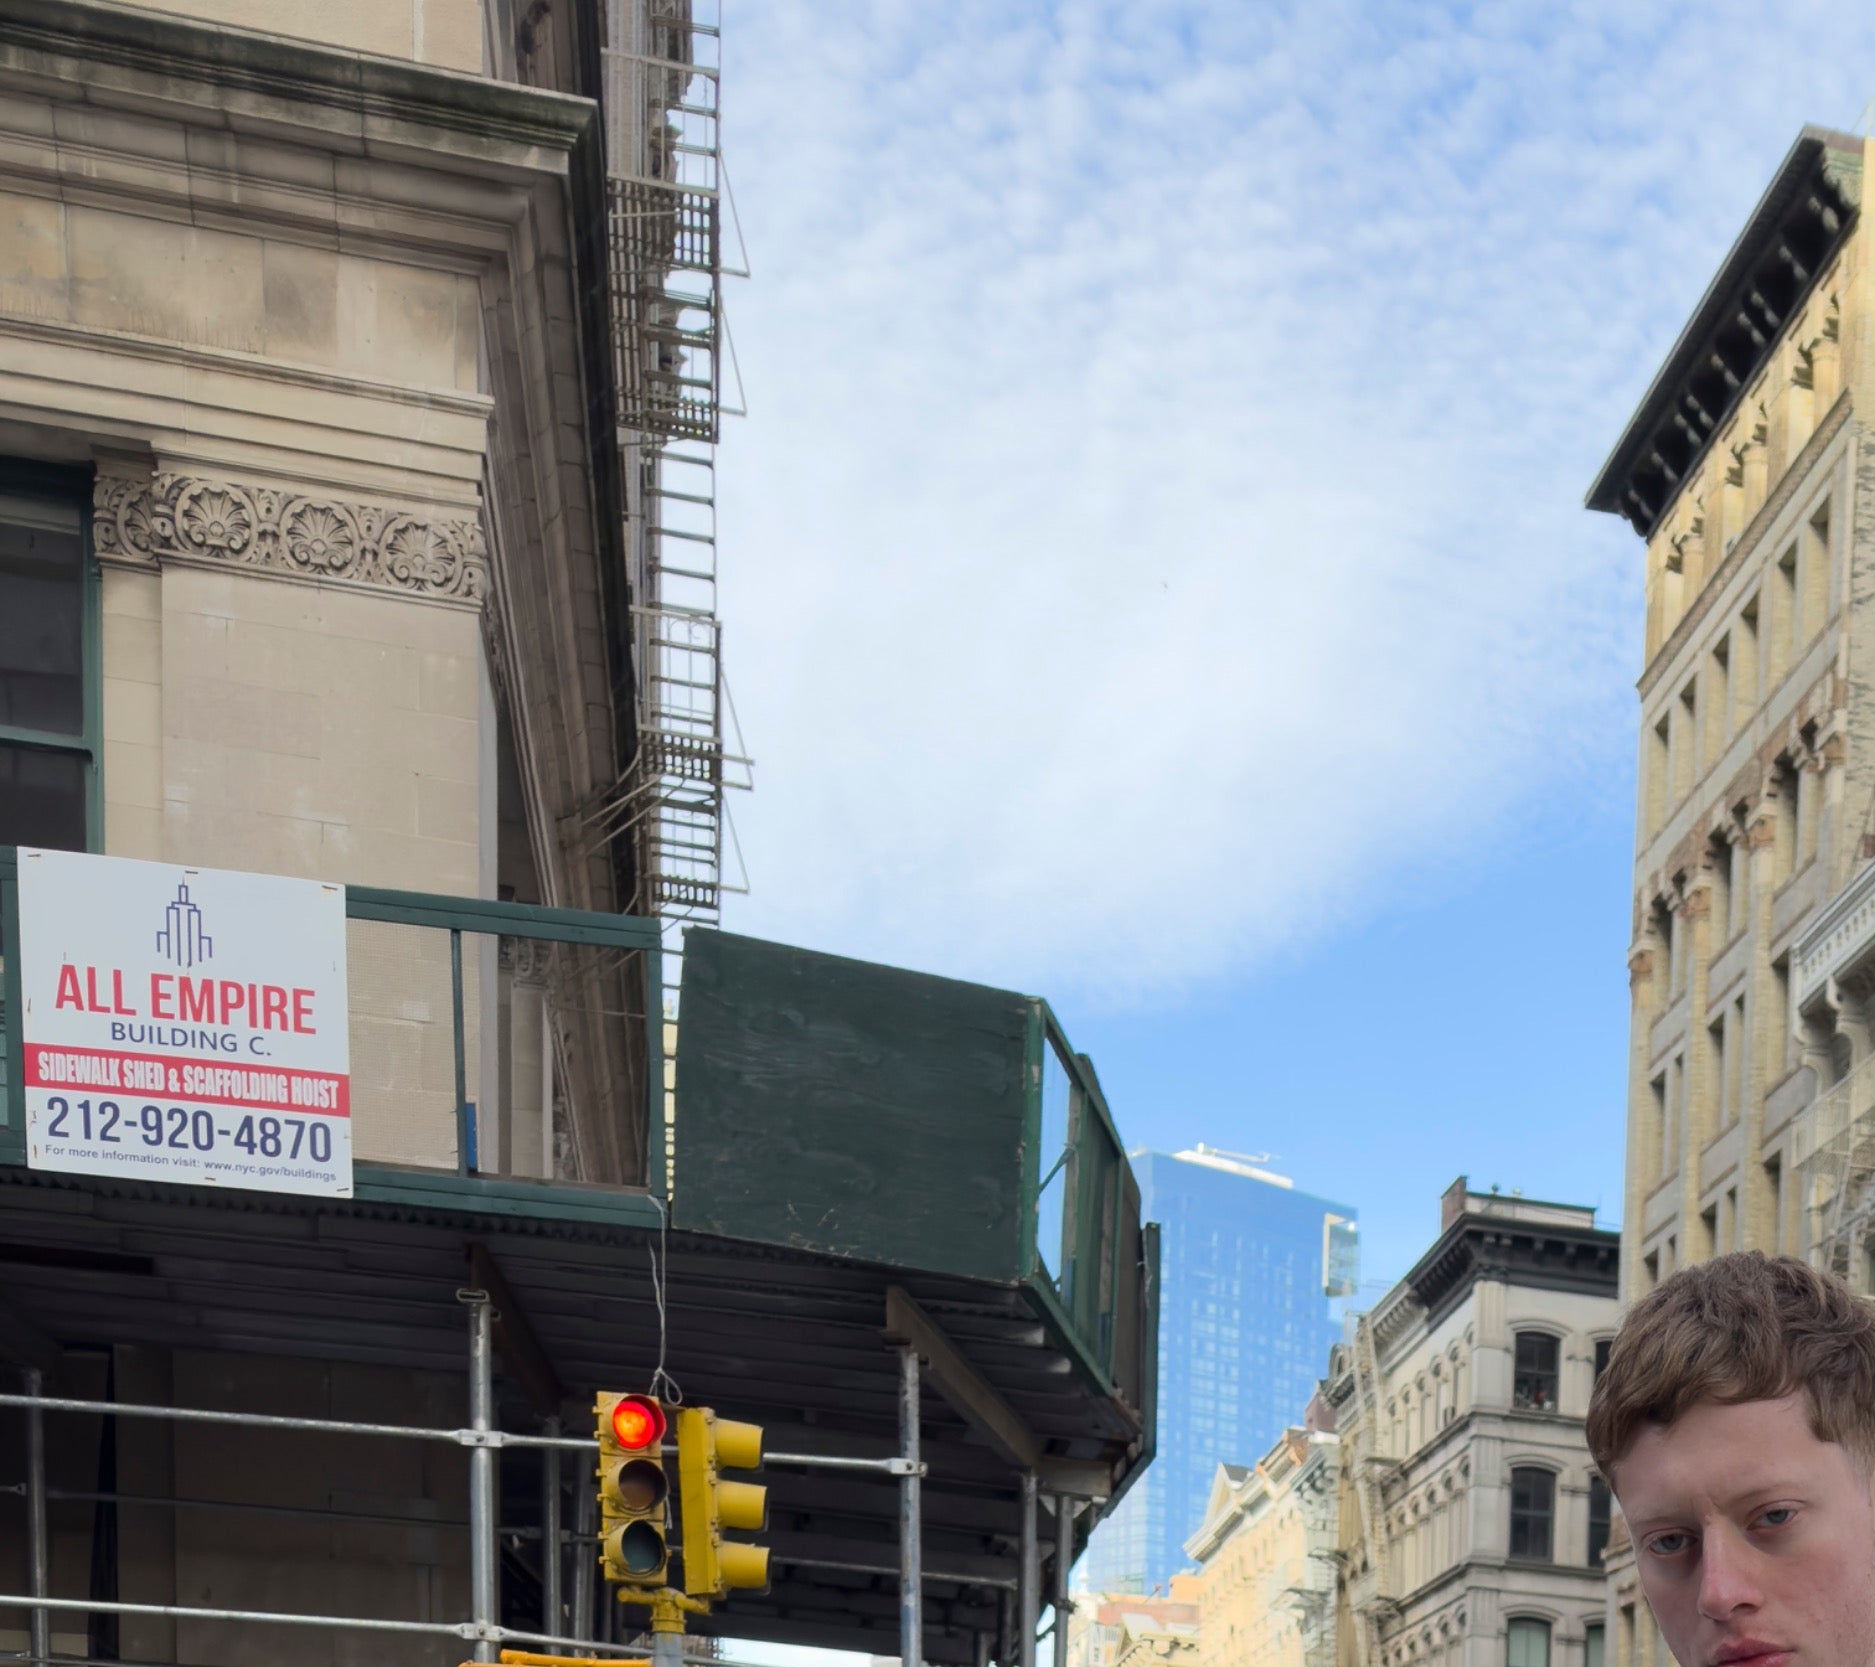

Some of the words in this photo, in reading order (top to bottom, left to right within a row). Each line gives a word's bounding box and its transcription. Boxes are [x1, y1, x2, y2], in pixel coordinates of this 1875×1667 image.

[55, 964, 137, 1016] ALL
[150, 973, 317, 1035] EMPIRE
[111, 1022, 238, 1053] BUILDING
[249, 1036, 272, 1056] C.
[38, 1051, 121, 1087] SIDEWALK
[123, 1059, 165, 1091] SHED
[168, 1067, 181, 1093] &
[183, 1065, 288, 1104] SCAFFOLDING
[291, 1079, 339, 1109] HOIST
[47, 1096, 332, 1163] 212-920-4870
[45, 1144, 65, 1156] For
[68, 1147, 99, 1159] more
[102, 1150, 169, 1165] information
[172, 1156, 200, 1168] visit:
[203, 1160, 337, 1183] www.nyc.gov/buildings
